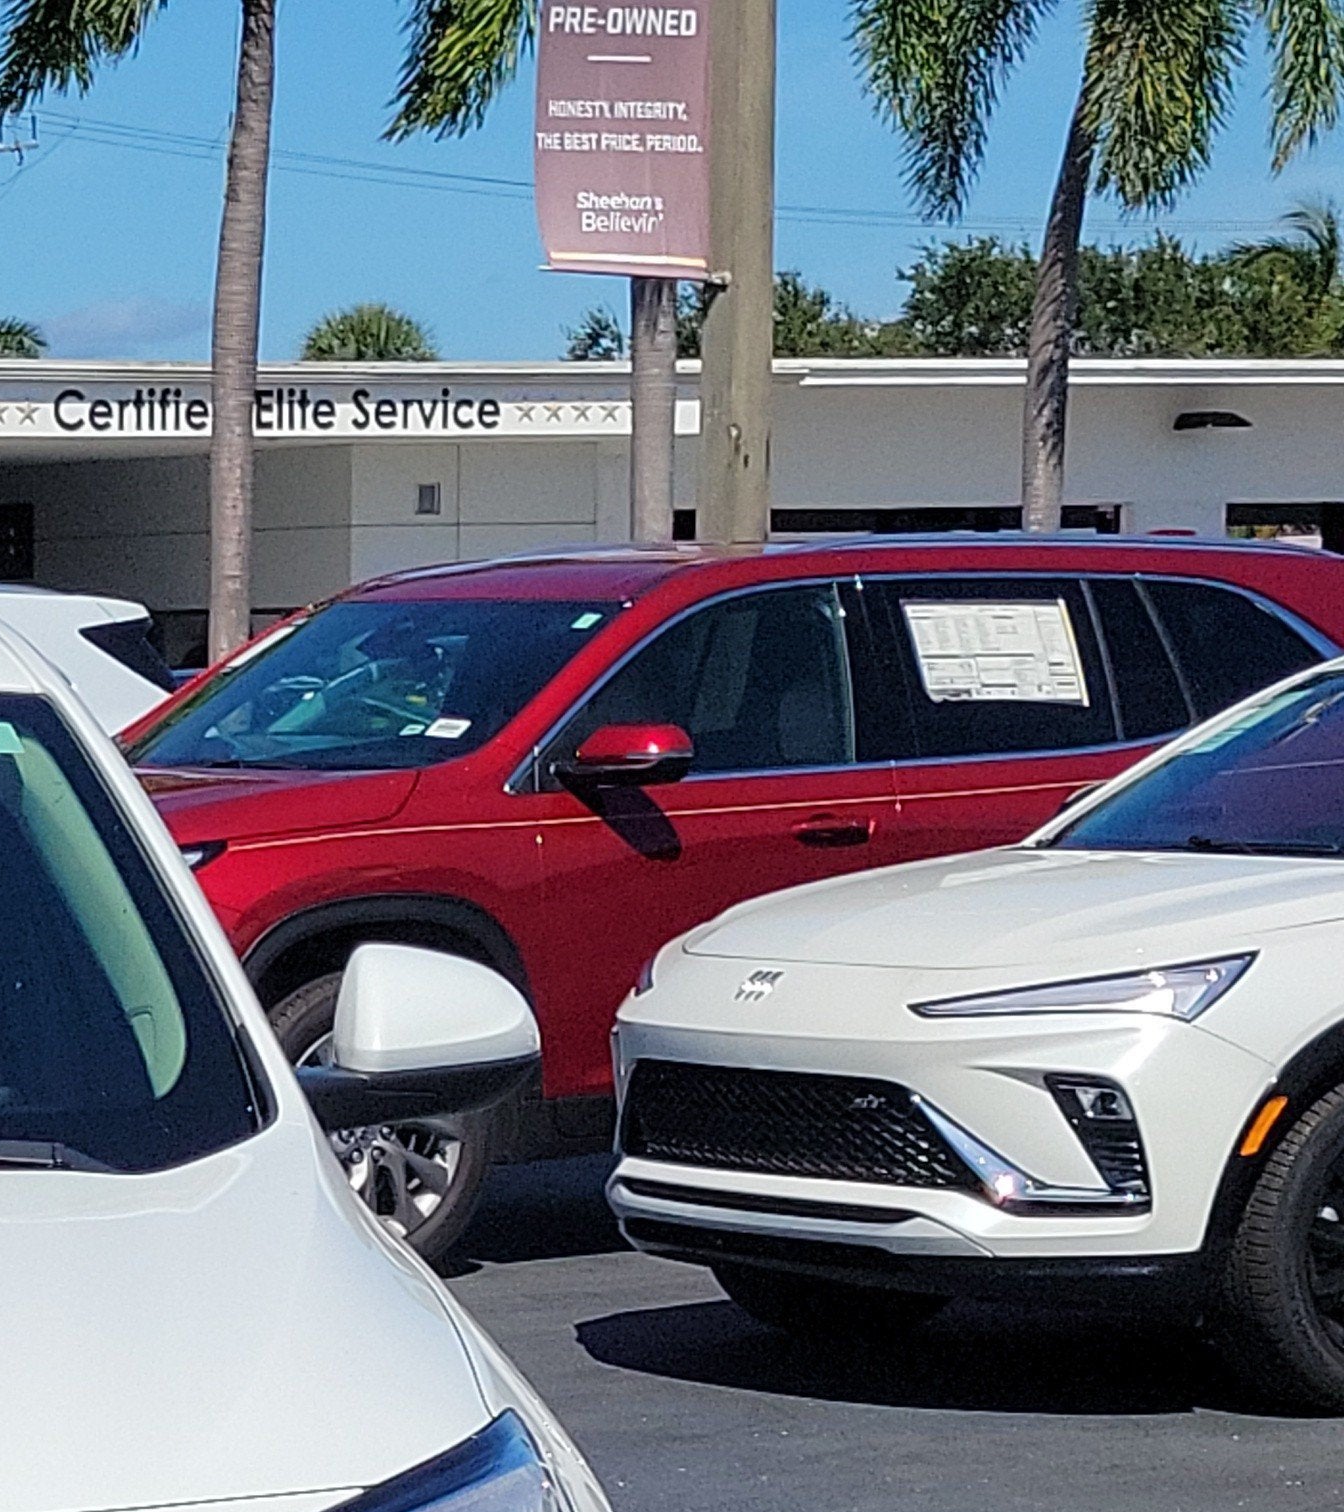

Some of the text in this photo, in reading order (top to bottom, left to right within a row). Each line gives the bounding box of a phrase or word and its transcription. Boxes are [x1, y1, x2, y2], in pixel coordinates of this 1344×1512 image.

[549, 7, 697, 36] PRE-OWNED
[536, 132, 561, 150] THE
[564, 132, 598, 151] BEST
[54, 387, 501, 431] Certifie Elite Service
